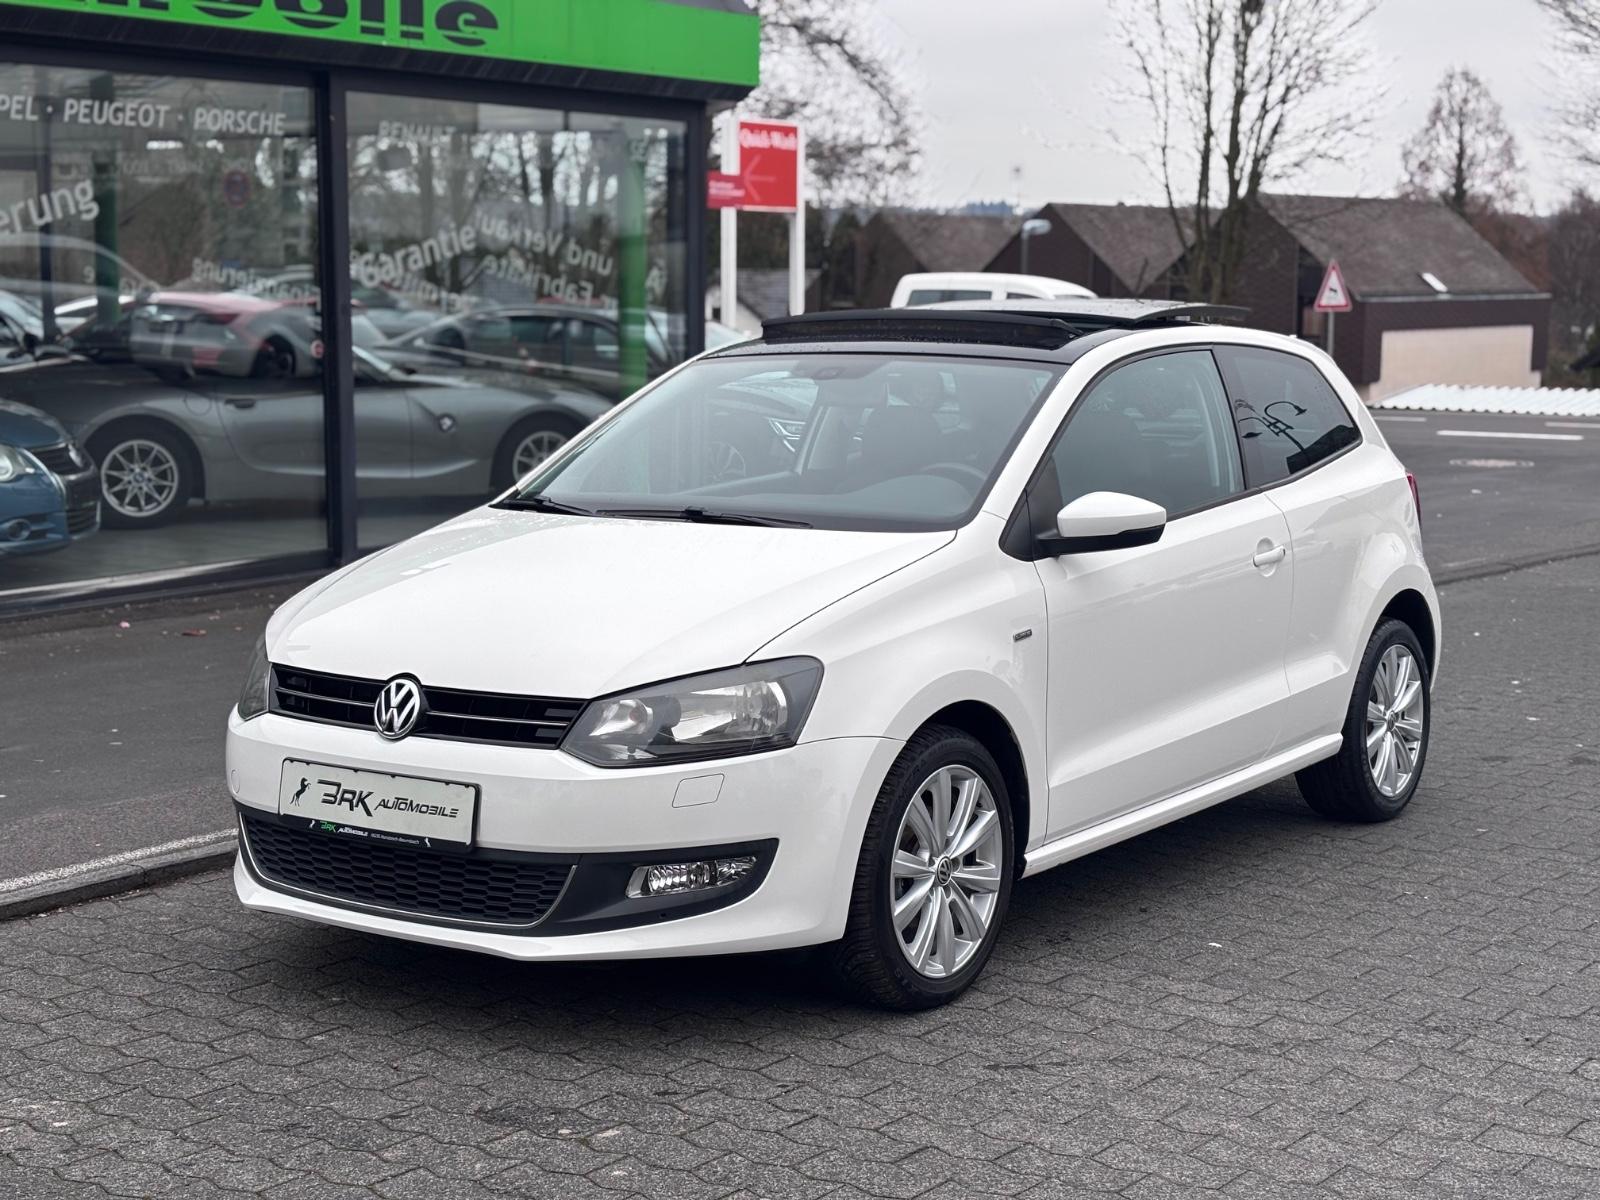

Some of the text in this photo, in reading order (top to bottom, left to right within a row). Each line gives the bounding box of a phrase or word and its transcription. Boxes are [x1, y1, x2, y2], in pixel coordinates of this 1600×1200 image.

[63, 98, 170, 128] PEUGEOT
[193, 108, 287, 136] PORSCHE
[360, 221, 478, 288] Garantie
